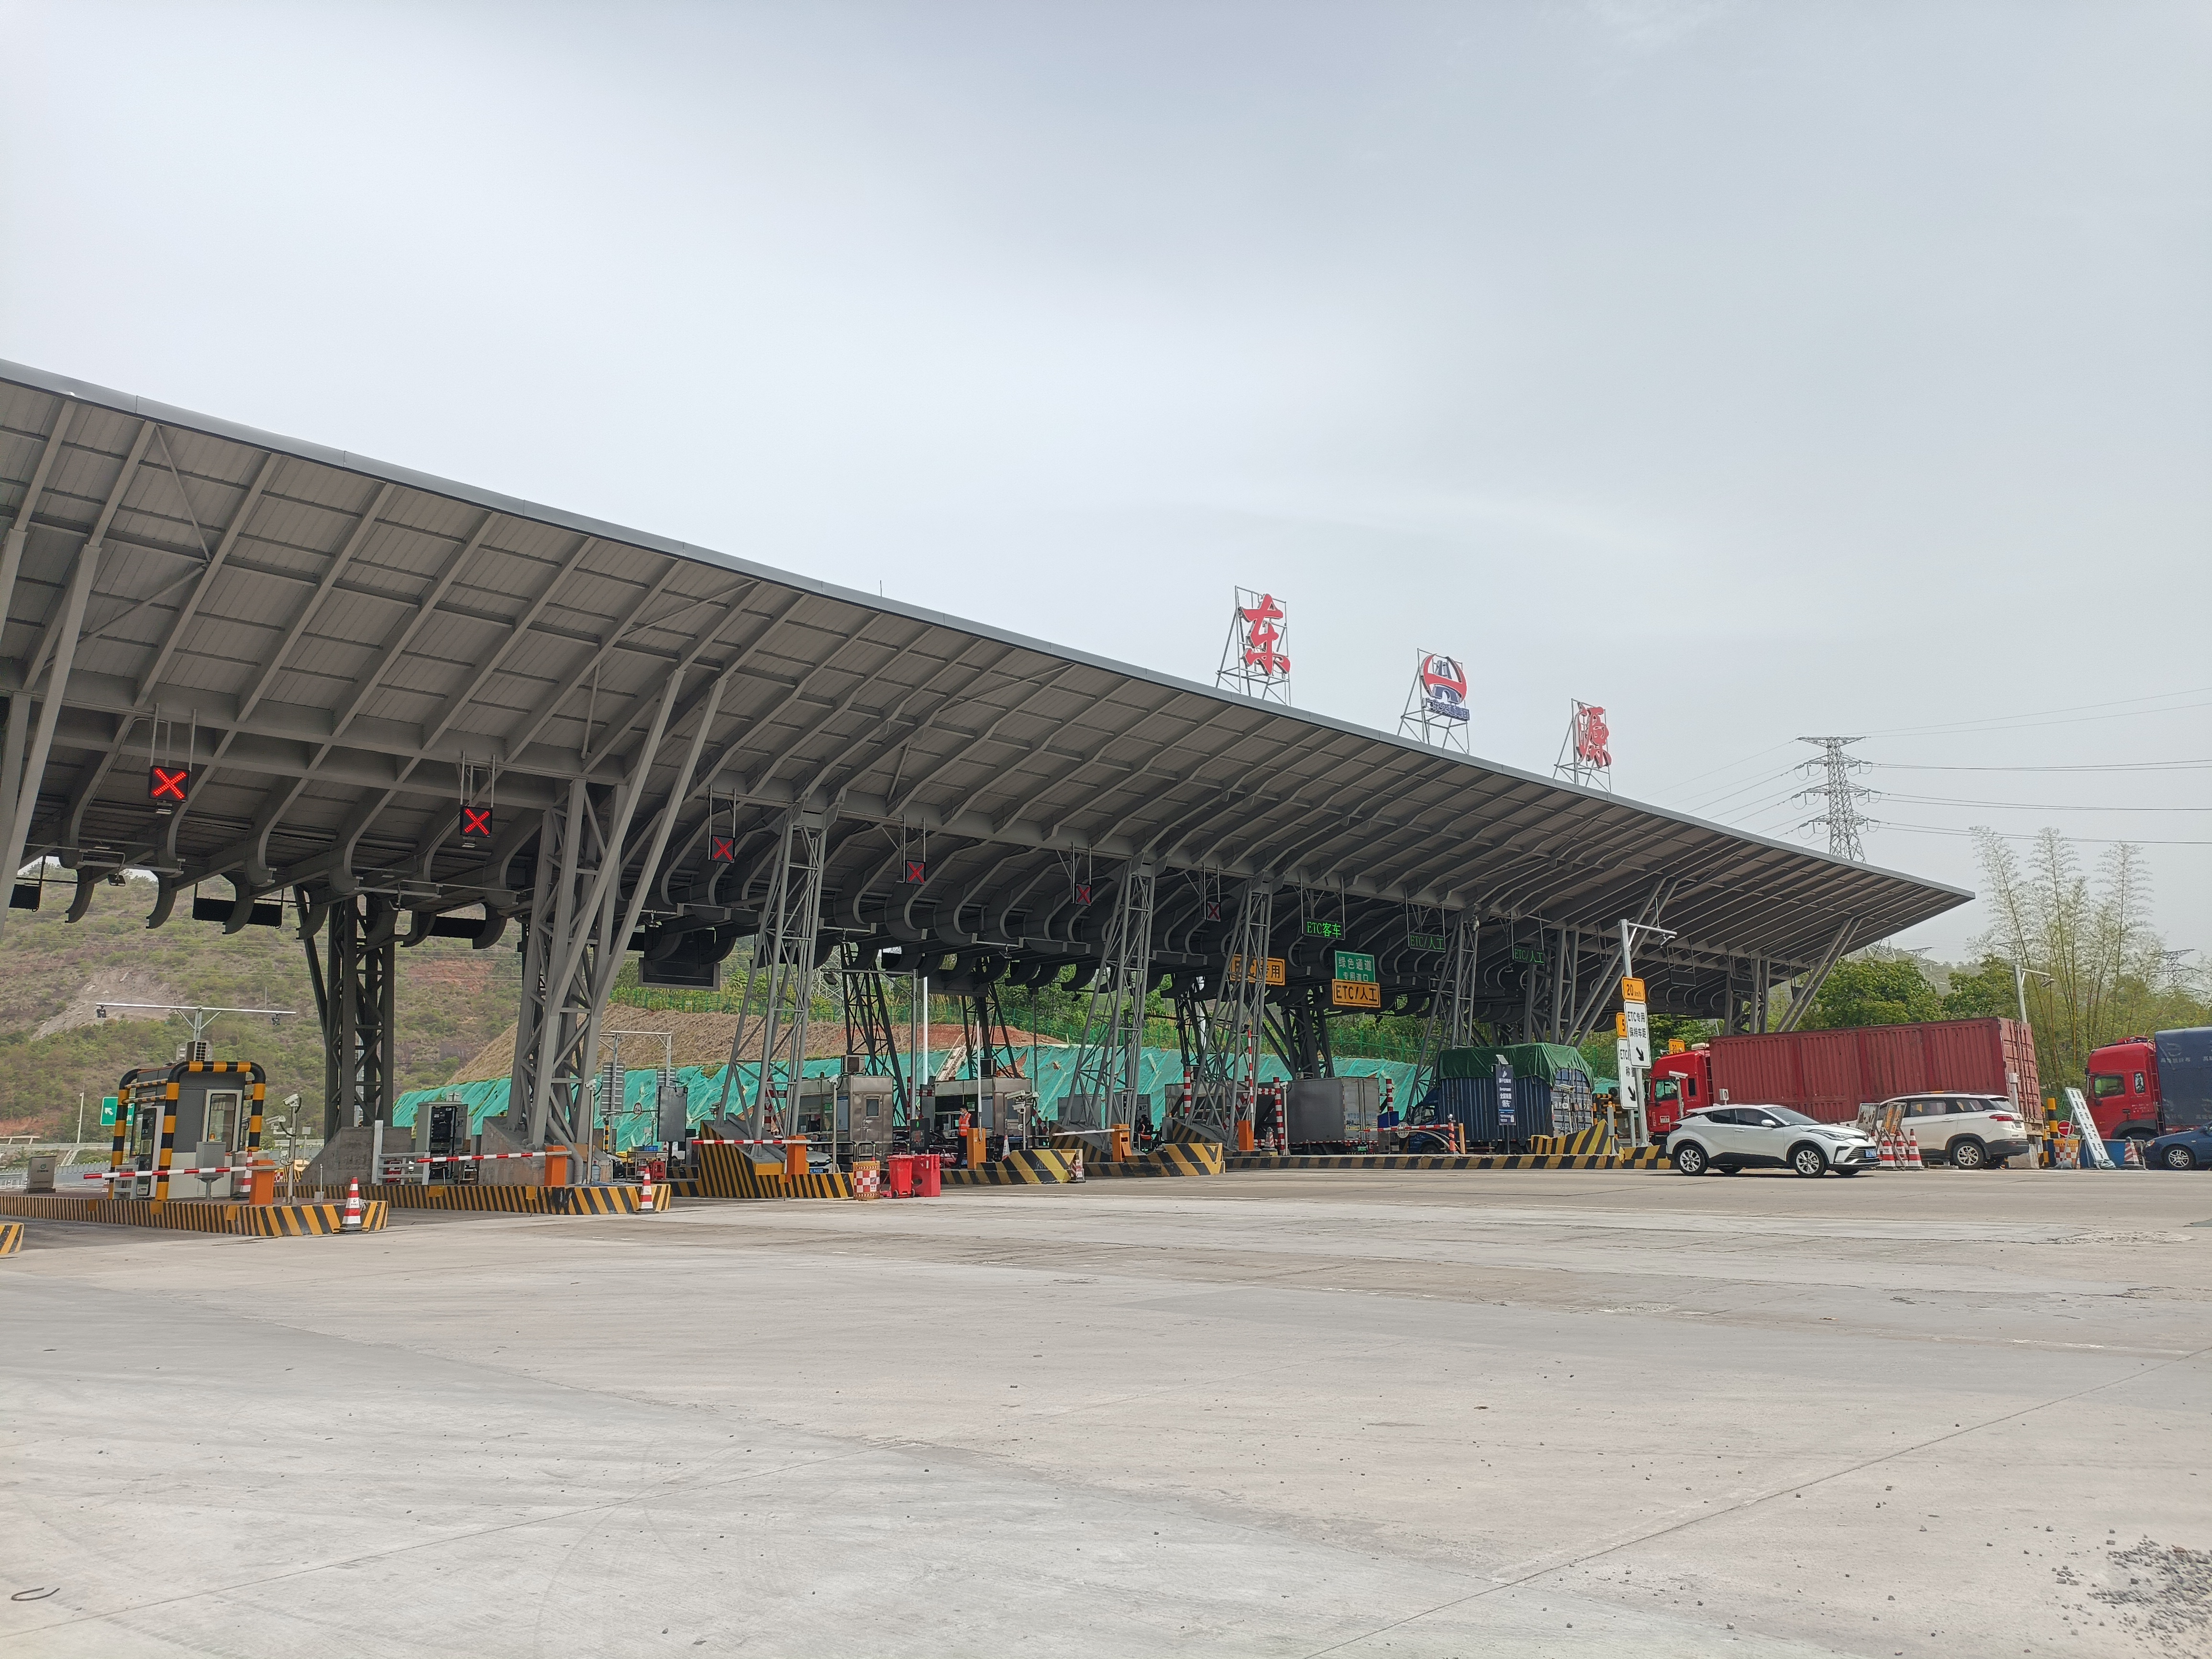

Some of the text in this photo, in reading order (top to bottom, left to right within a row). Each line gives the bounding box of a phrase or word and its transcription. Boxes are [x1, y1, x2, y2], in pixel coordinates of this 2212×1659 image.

[1238, 593, 1612, 768] 东 源
[1306, 921, 1341, 939] ETC客车
[1410, 934, 1445, 950] ETC/人工
[1514, 948, 1544, 963] ETC/人工
[1338, 956, 1371, 971] 绿色通道
[1343, 972, 1368, 982] 专用道口
[1336, 984, 1378, 1002] ETC/人工
[1626, 984, 1634, 996] 20
[1627, 1011, 1646, 1023] ETC专用
[1629, 1027, 1647, 1038] 保持车距
